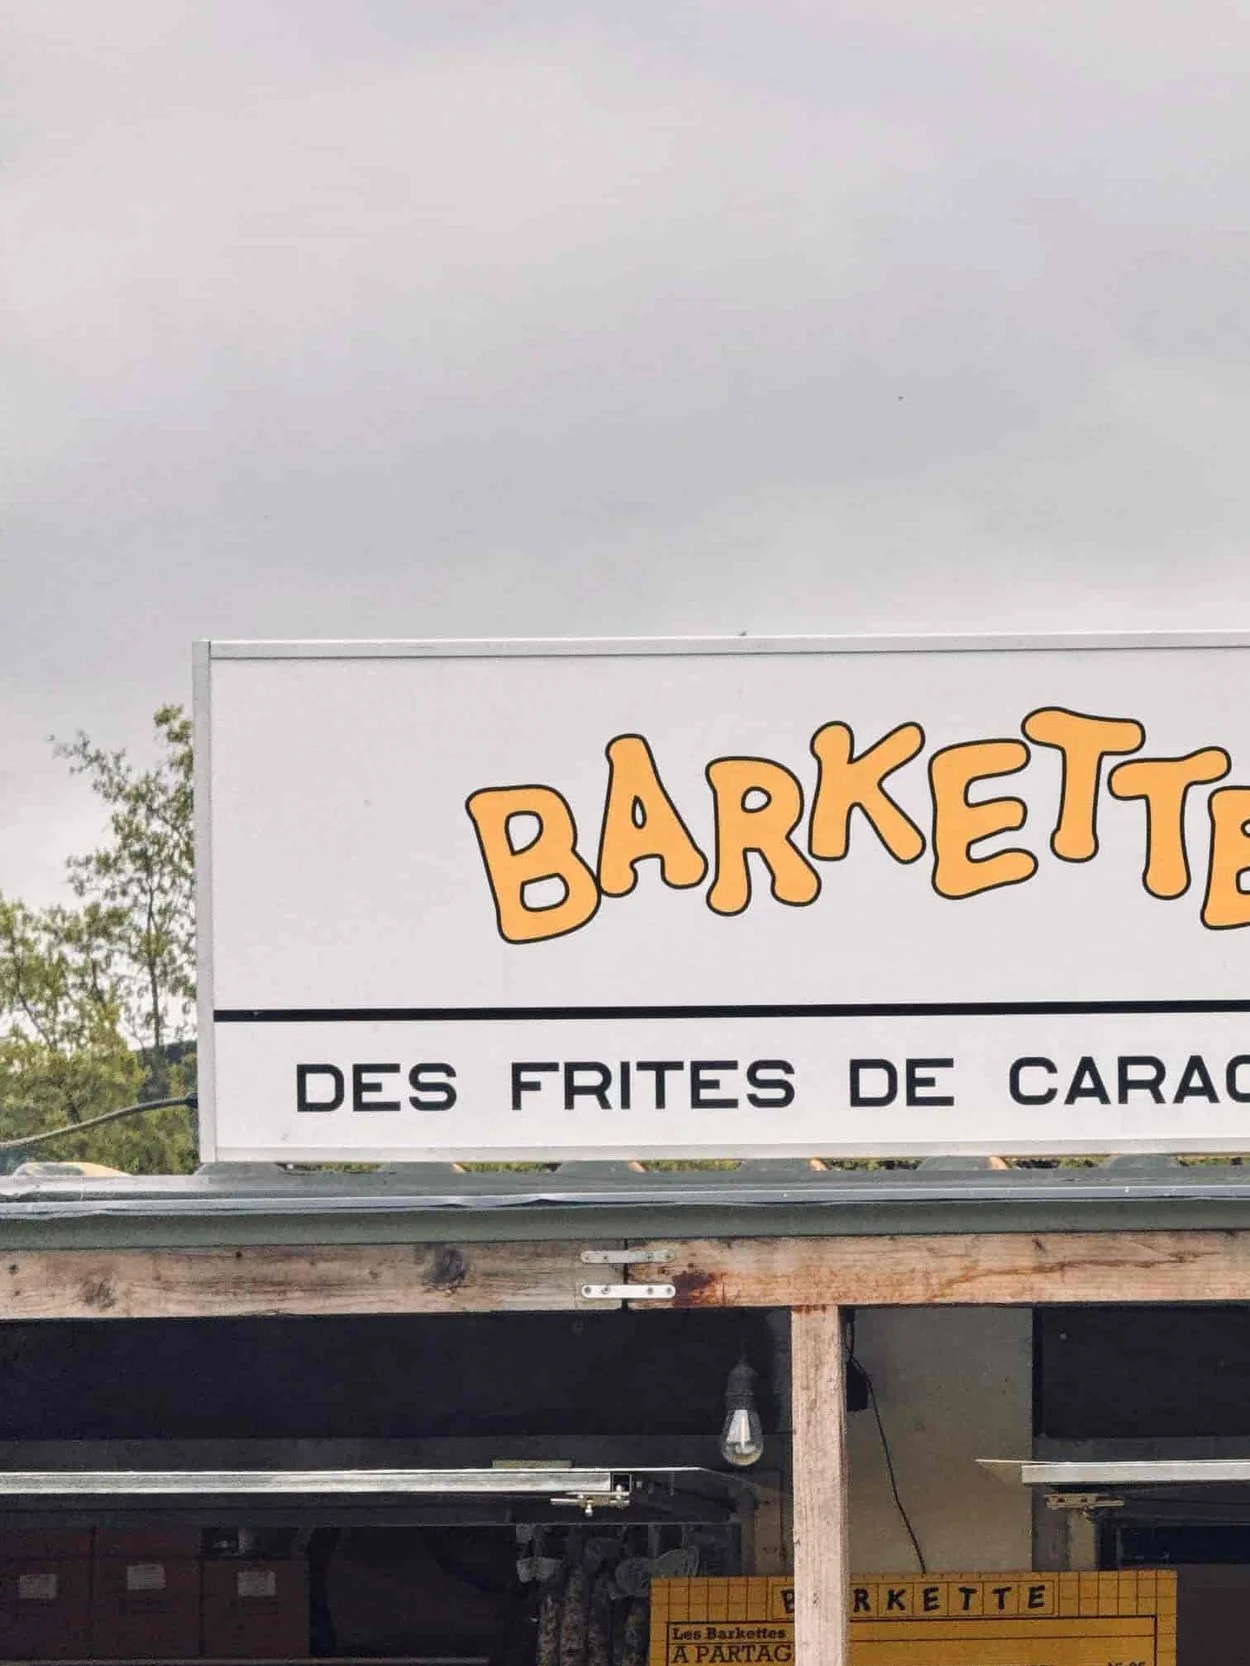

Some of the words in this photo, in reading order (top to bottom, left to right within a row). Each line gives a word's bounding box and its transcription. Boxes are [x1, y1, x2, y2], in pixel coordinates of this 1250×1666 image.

[297, 1062, 459, 1113] DES
[511, 1058, 797, 1109] FRITES
[849, 1057, 956, 1107] DE
[781, 1584, 1045, 1616] BRKETTE
[672, 1627, 701, 1640] Les
[706, 1627, 785, 1640] Barkettes
